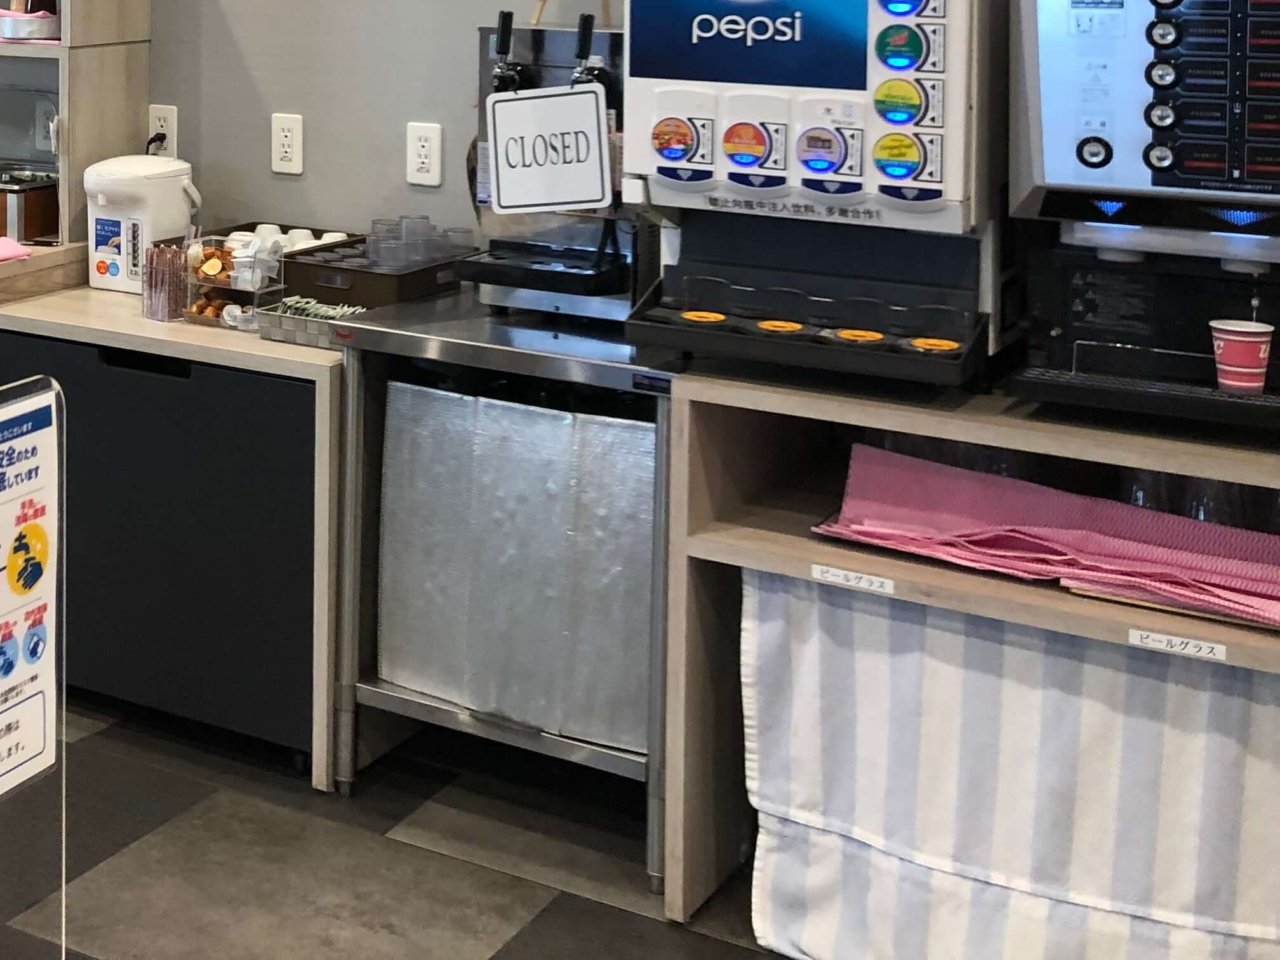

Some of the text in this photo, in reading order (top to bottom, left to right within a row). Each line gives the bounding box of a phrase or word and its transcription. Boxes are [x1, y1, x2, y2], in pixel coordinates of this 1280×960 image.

[691, 11, 802, 47] pepsi
[505, 130, 590, 169] CLOSED
[820, 567, 886, 591] ビールグラス
[1138, 633, 1218, 657] ビールグラス
